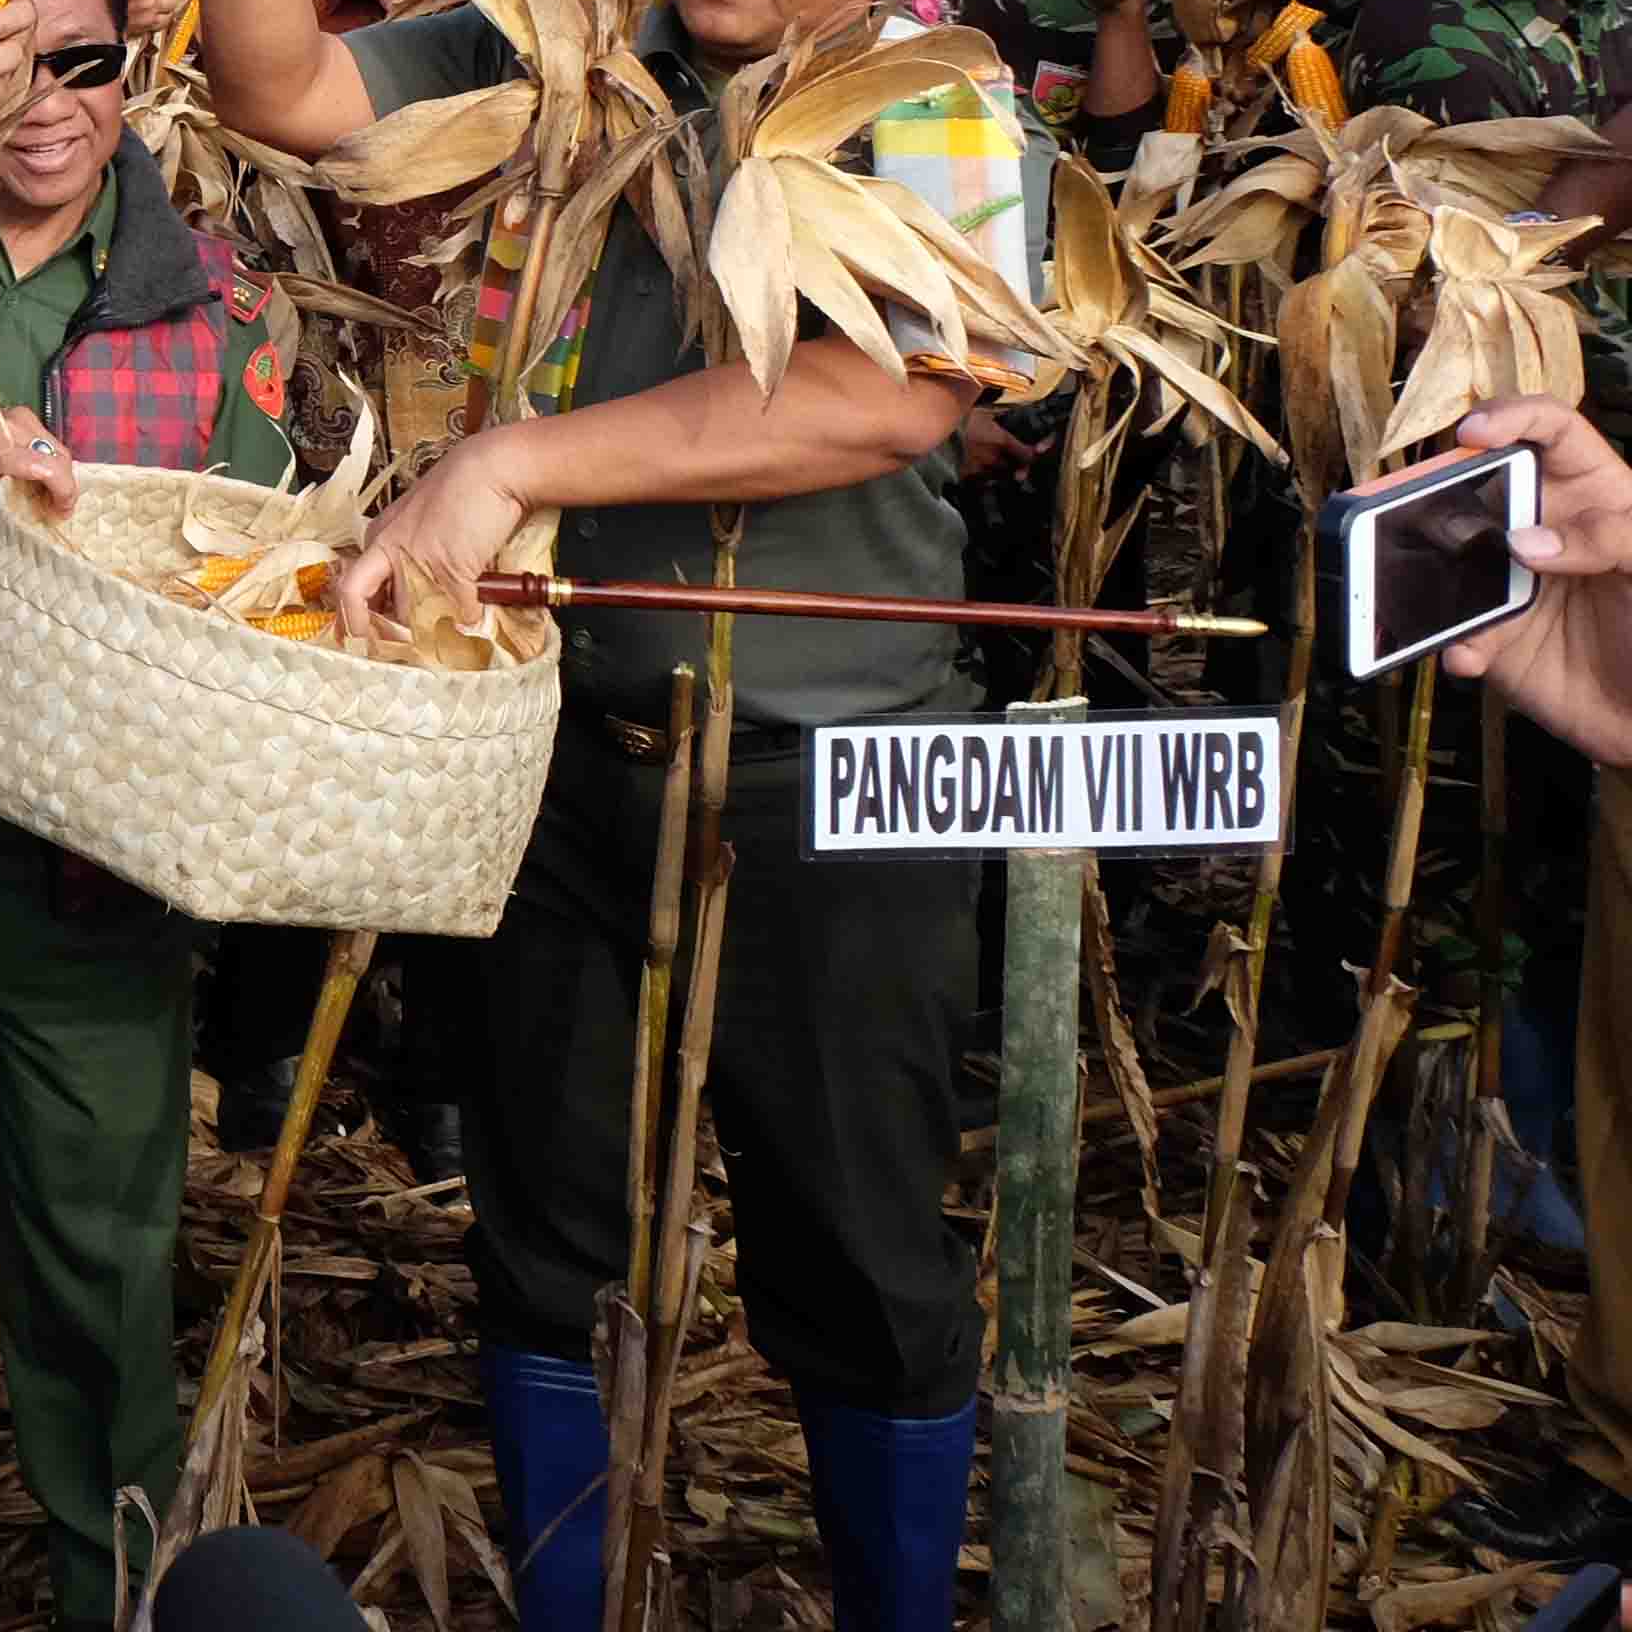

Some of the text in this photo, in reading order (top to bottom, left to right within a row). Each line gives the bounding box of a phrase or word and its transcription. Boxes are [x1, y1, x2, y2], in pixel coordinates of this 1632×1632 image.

[829, 730, 1266, 835] PANGDAM VII WRB
